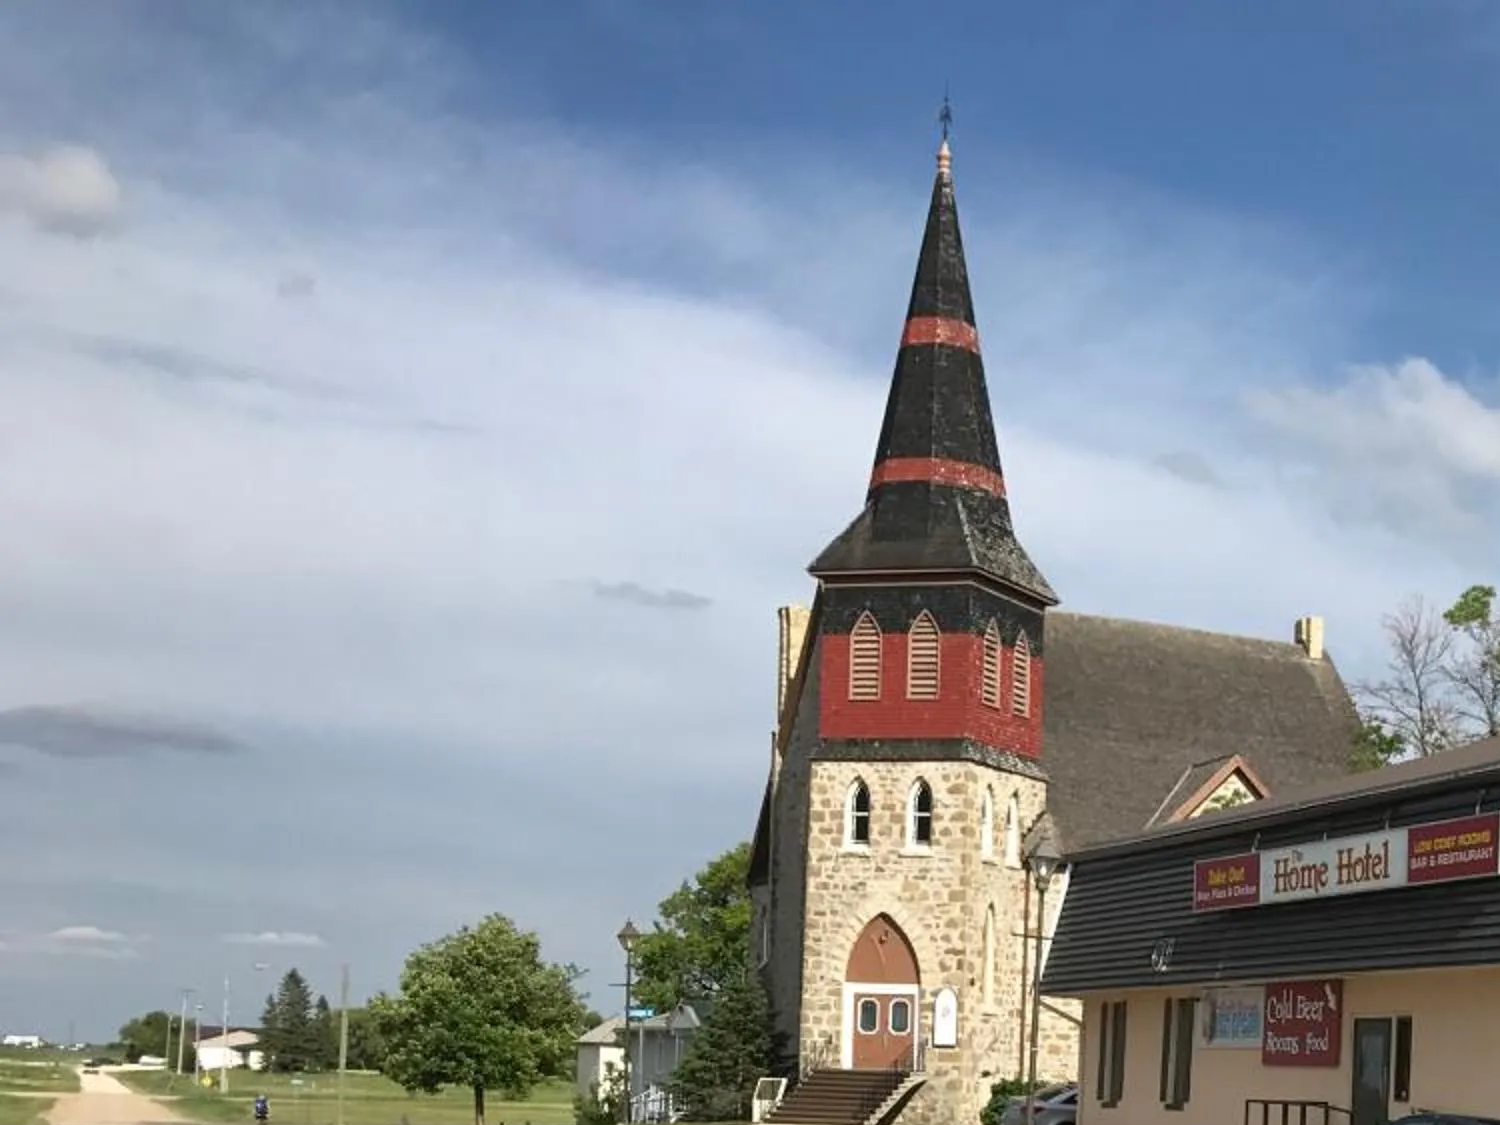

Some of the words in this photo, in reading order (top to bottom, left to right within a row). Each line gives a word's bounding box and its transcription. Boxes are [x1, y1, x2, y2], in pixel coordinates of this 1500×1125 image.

[1274, 857, 1329, 895] Home
[1337, 839, 1391, 886] Hotel
[1267, 988, 1294, 1024] Cold
[1296, 995, 1326, 1022] Beer
